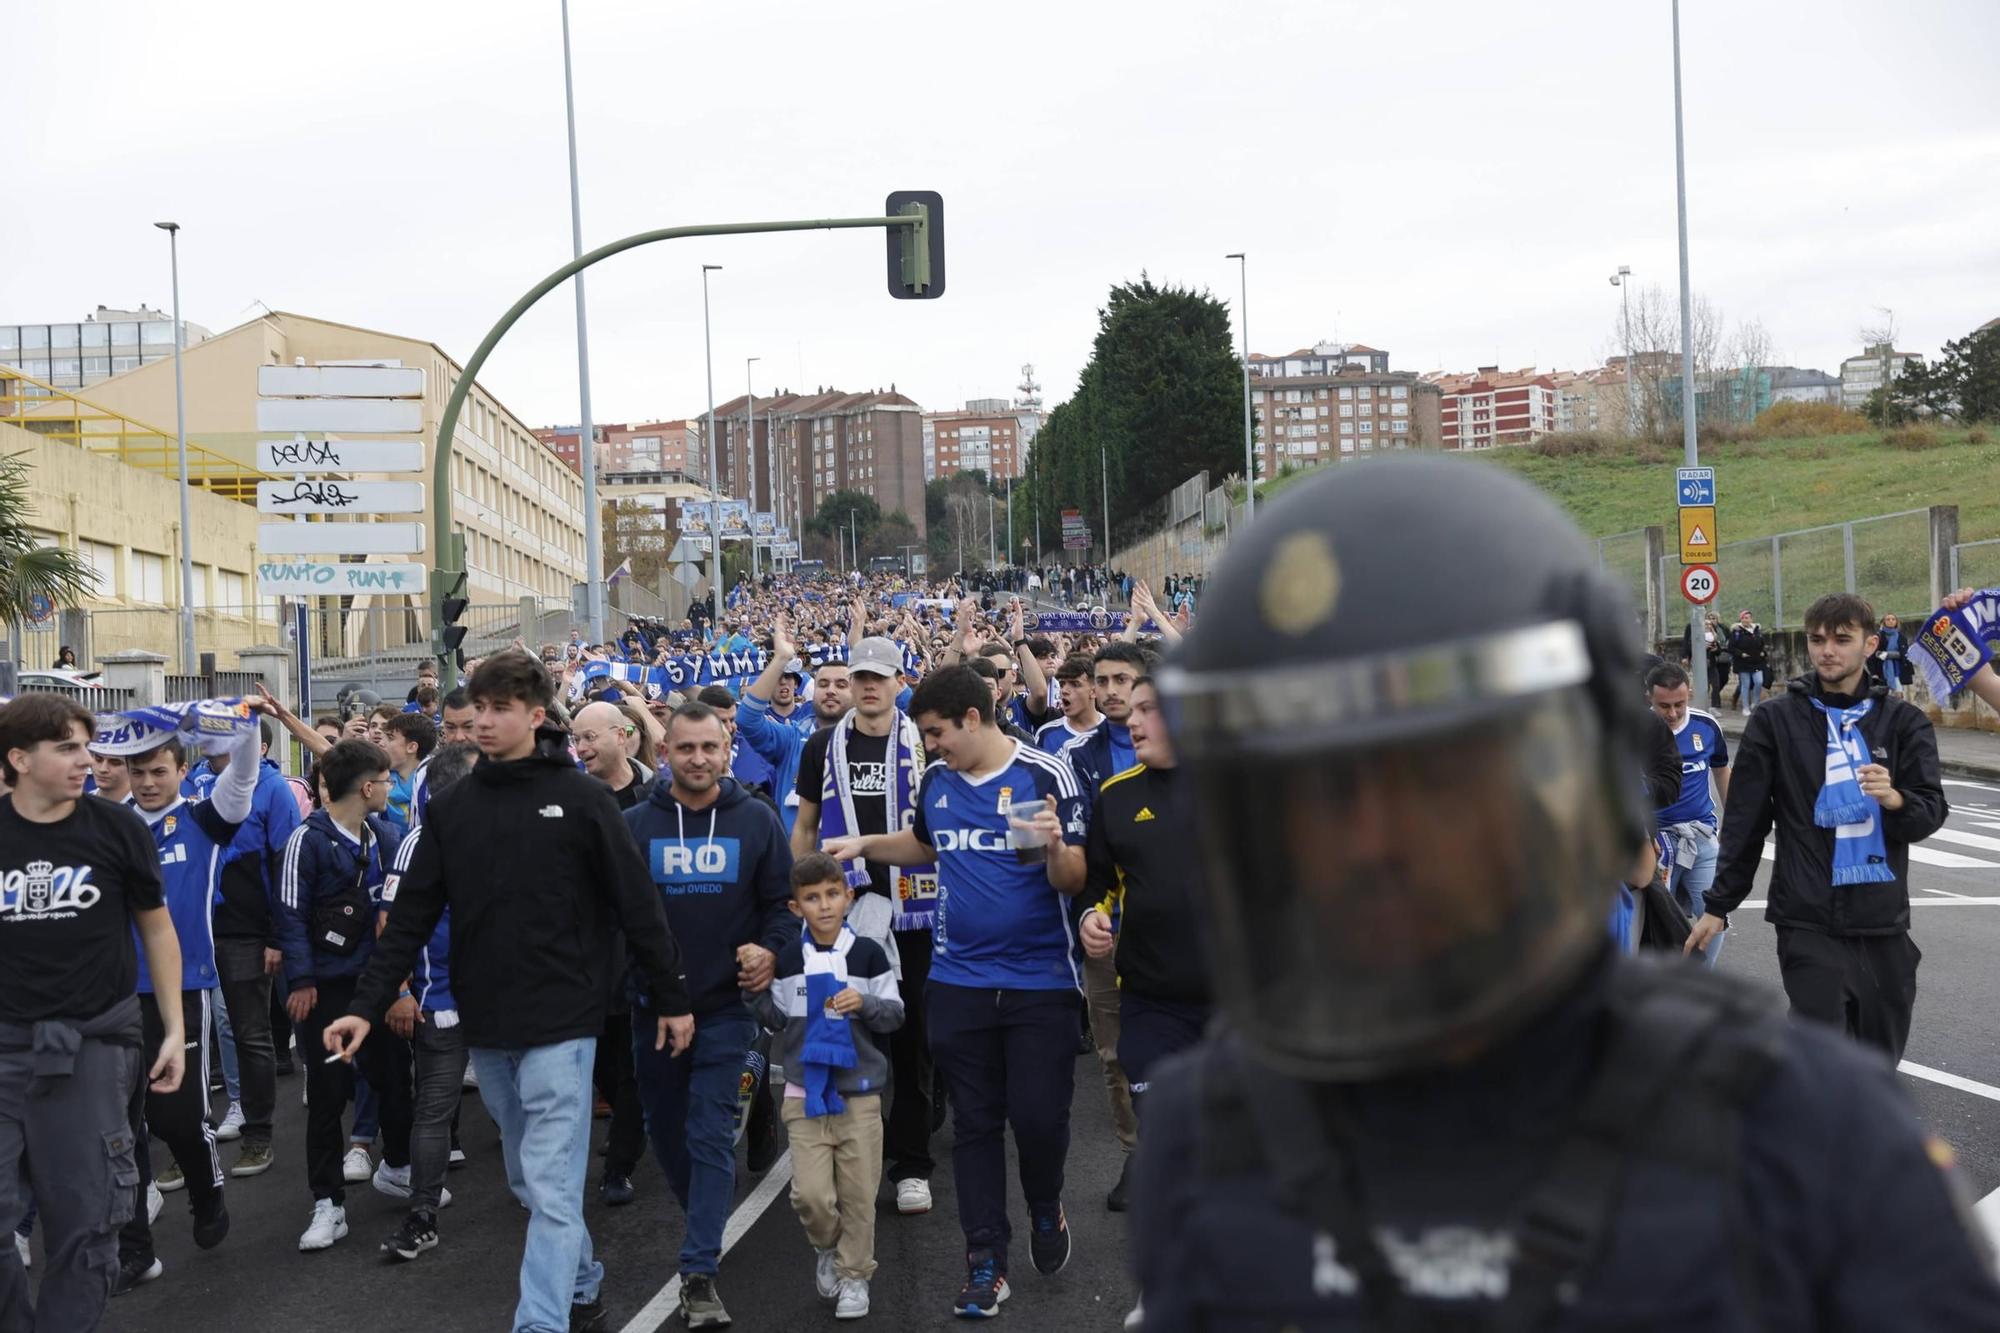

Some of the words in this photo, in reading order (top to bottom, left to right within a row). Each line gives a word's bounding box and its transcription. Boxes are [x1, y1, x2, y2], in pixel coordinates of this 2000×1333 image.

[259, 563, 336, 584] PUNTO
[1691, 578, 1710, 590] 20
[1038, 612, 1057, 620] REAL
[1060, 611, 1089, 620] OVIEDO
[1921, 631, 1950, 663] DESDE
[1948, 662, 1964, 684] 1926
[663, 844, 726, 875] RO
[666, 885, 685, 895] Real
[687, 883, 722, 894] OVIEDO
